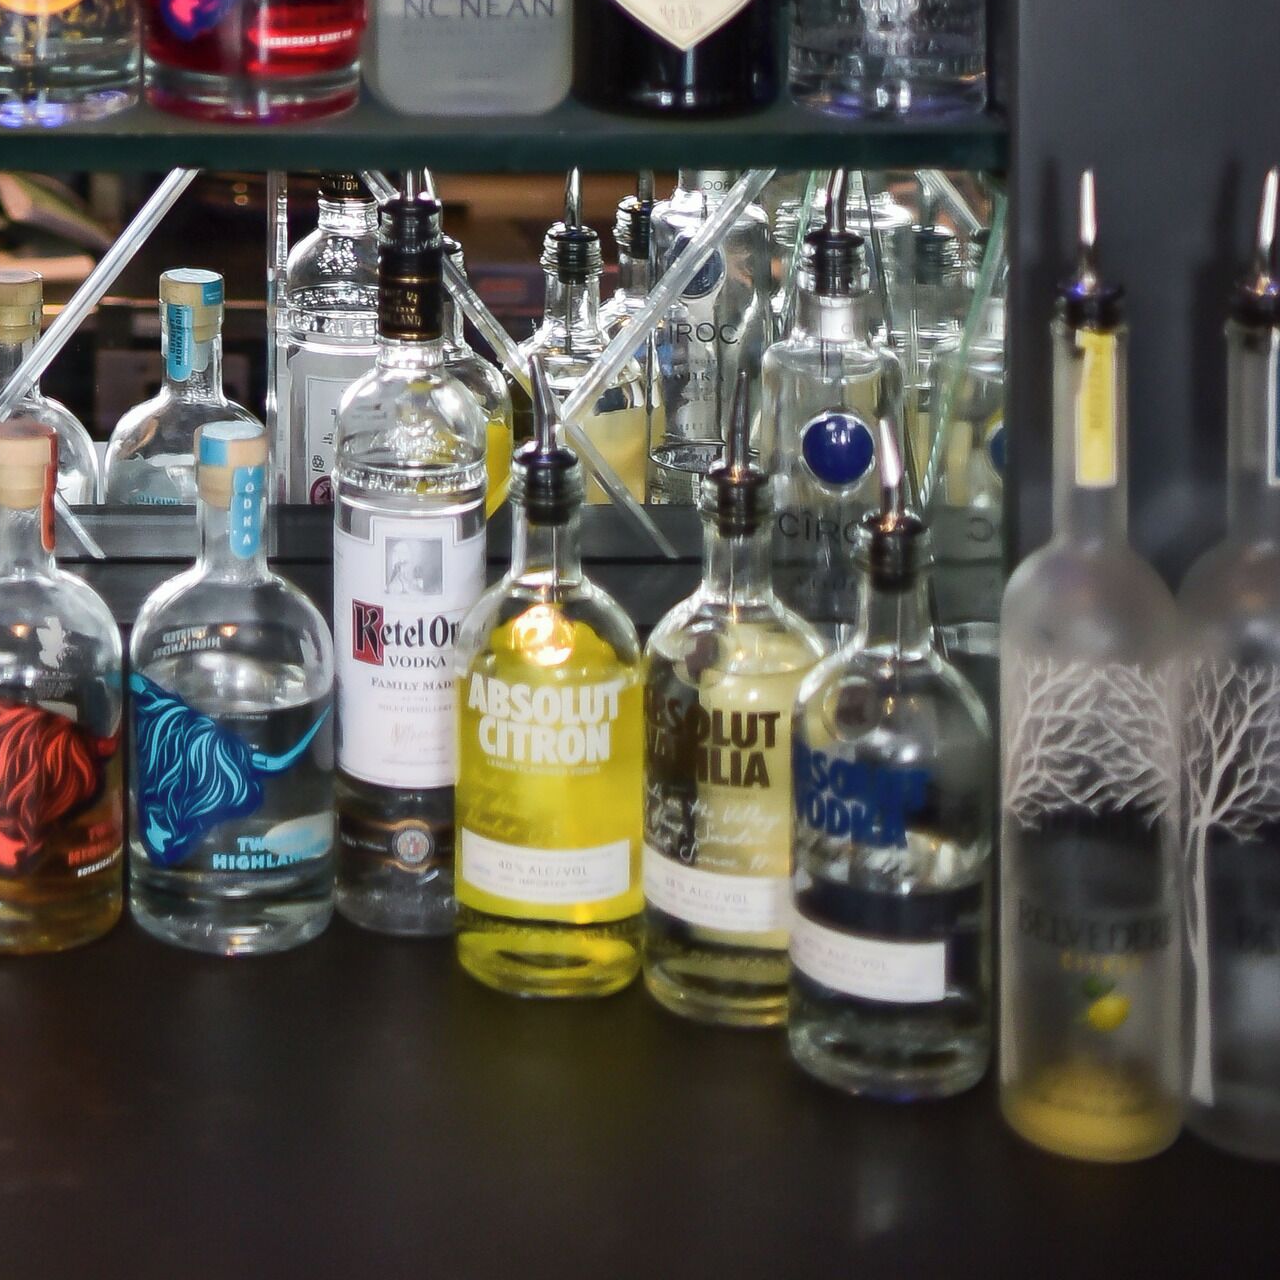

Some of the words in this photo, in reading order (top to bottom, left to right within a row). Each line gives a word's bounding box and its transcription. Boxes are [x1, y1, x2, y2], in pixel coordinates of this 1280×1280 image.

[242, 466, 256, 546] VODKA
[778, 510, 859, 544] CÎRO
[353, 602, 425, 662] Ketel
[371, 676, 418, 691] FAMILY
[422, 679, 455, 689] MAD
[388, 655, 447, 669] VODKA
[468, 672, 622, 725] ABSOLUT
[479, 715, 611, 765] CITRON
